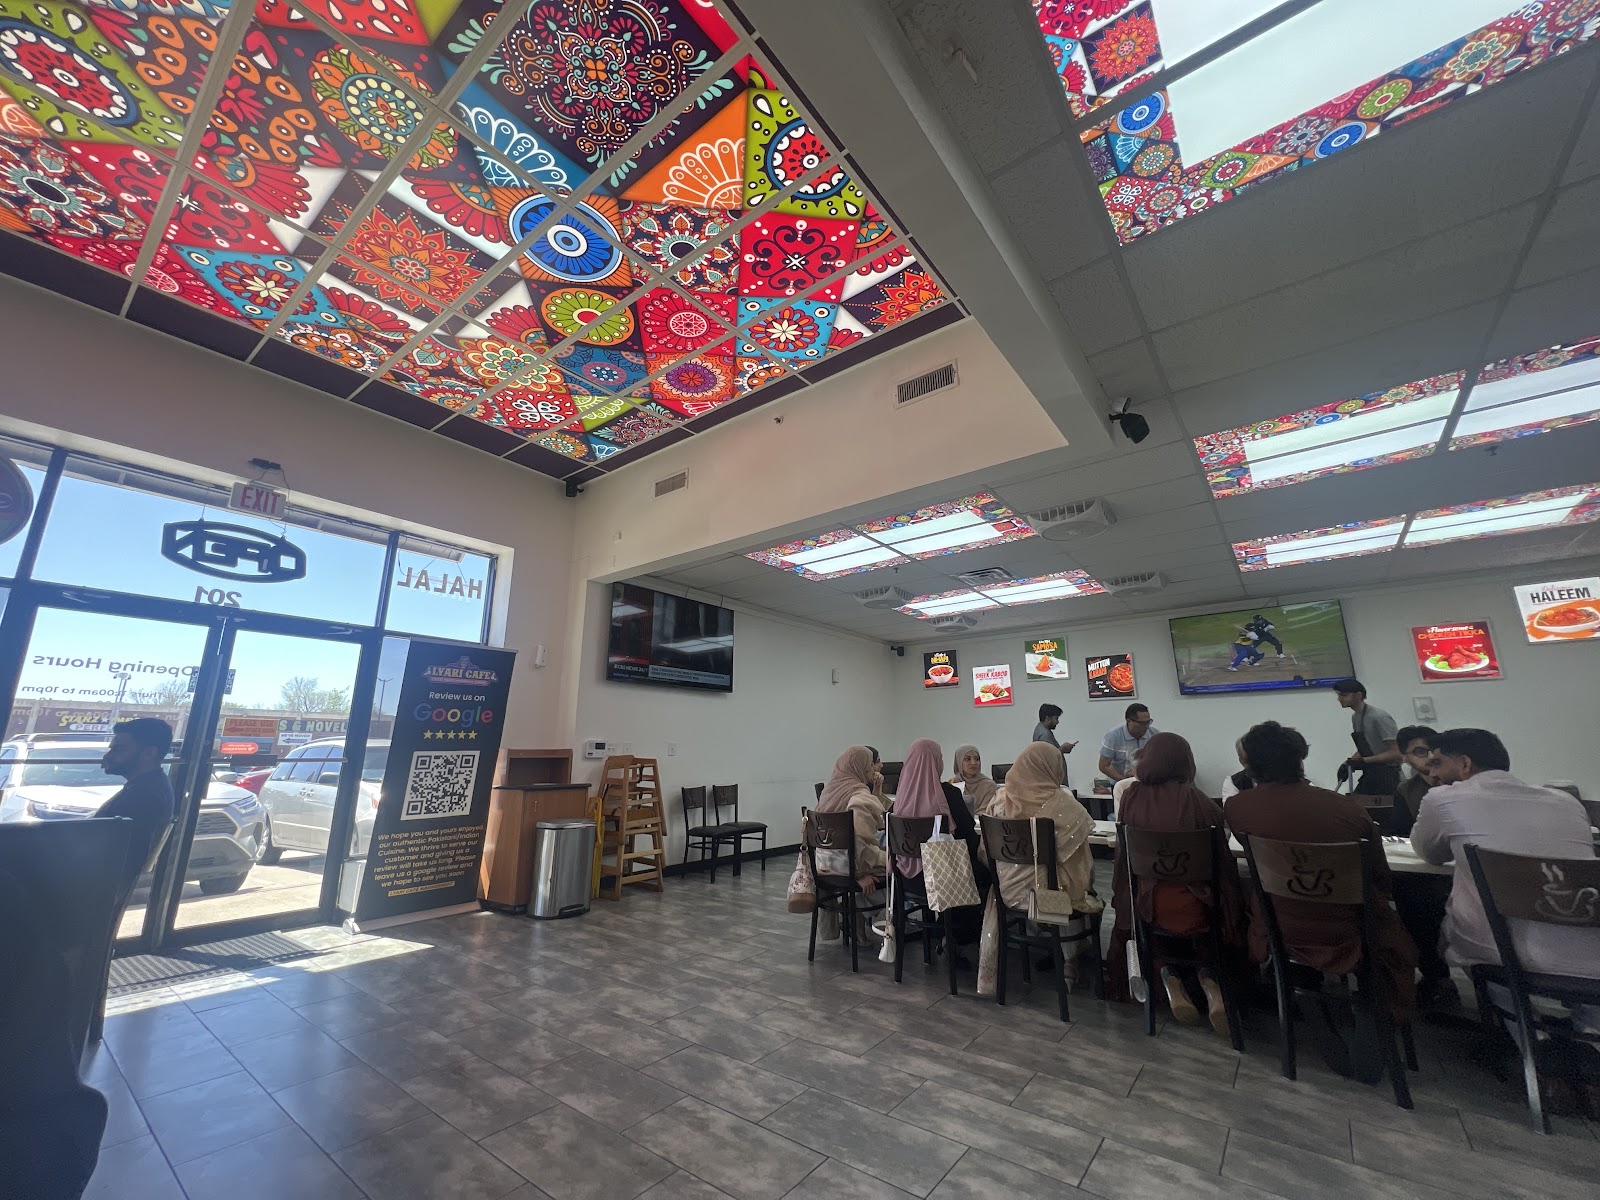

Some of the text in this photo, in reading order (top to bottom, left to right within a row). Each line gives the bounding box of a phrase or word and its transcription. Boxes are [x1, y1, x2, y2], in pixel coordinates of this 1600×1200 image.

[240, 485, 281, 514] EXIT
[1530, 587, 1590, 603] HALEEM
[1418, 629, 1485, 639] CHICKEN TIKKA
[1032, 641, 1058, 651] SAMOSA
[1088, 658, 1110, 671] MUTTON
[431, 666, 490, 680] LYARI CAFE
[429, 692, 461, 700] Review
[413, 702, 494, 728] Google
[59, 715, 100, 726] STARZ
[229, 719, 257, 727] PLEASE
[75, 723, 110, 731] PERF
[292, 720, 301, 731] &
[305, 720, 347, 732] NOVEL
[440, 827, 457, 835] yours
[393, 838, 426, 846] authentic
[385, 854, 419, 863] customer
[435, 849, 455, 858] giving
[413, 866, 437, 876] google
[394, 878, 413, 886] hope
